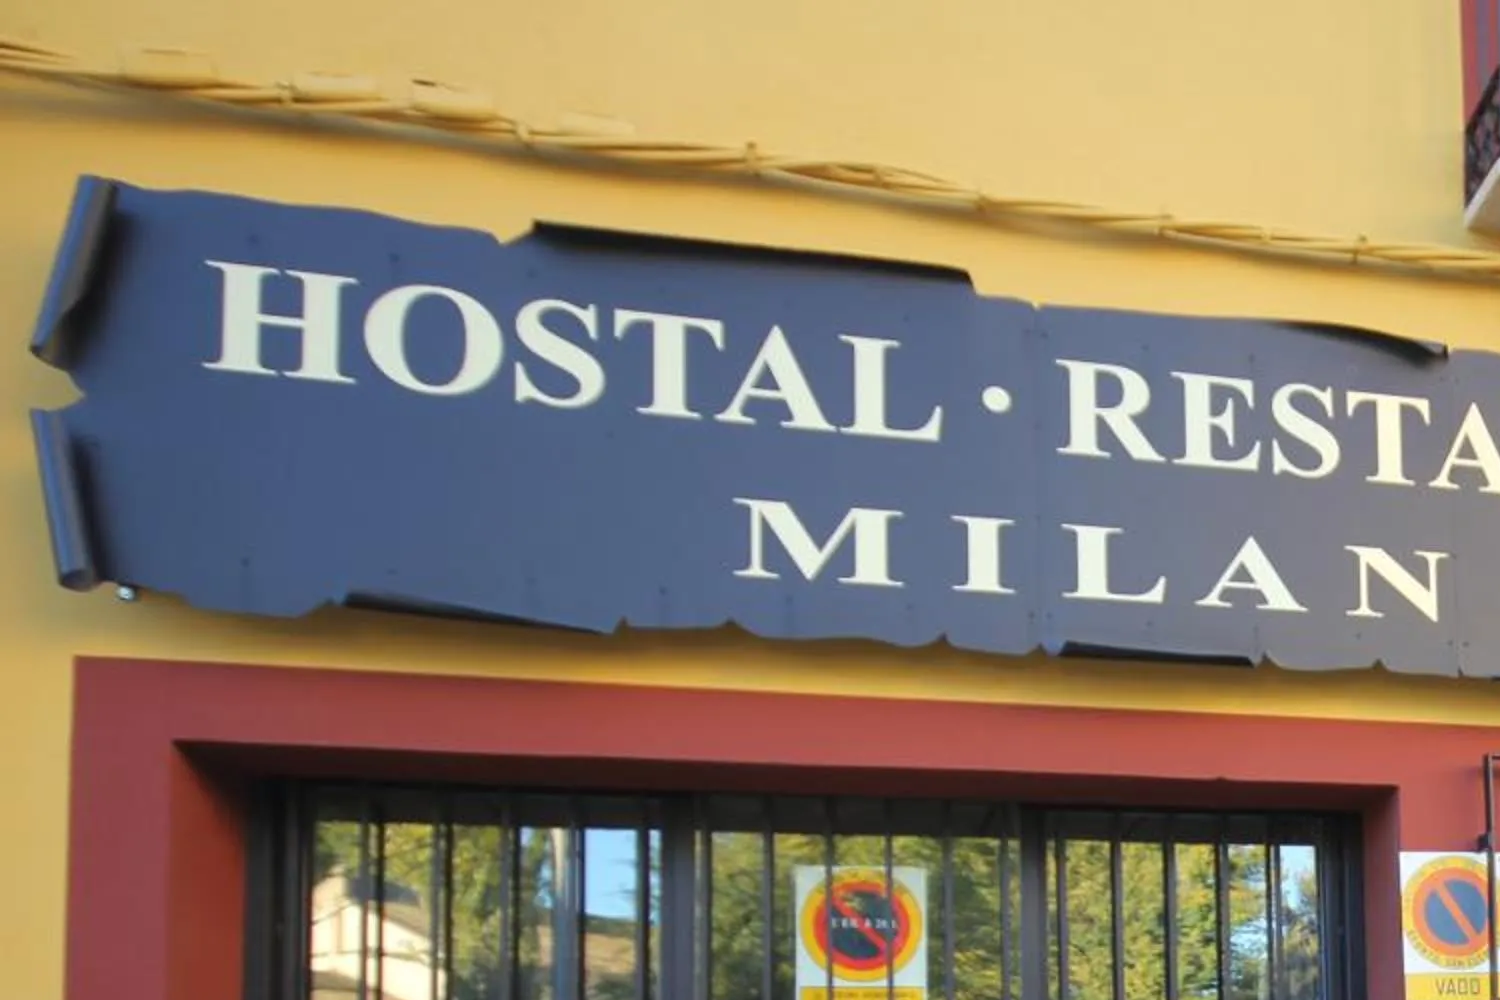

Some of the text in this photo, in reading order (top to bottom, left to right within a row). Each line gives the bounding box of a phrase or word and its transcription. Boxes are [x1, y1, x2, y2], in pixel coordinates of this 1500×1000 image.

[203, 260, 943, 442] HOSTAL
[733, 497, 1449, 623] MILAN
[1435, 977, 1481, 996] VADO
